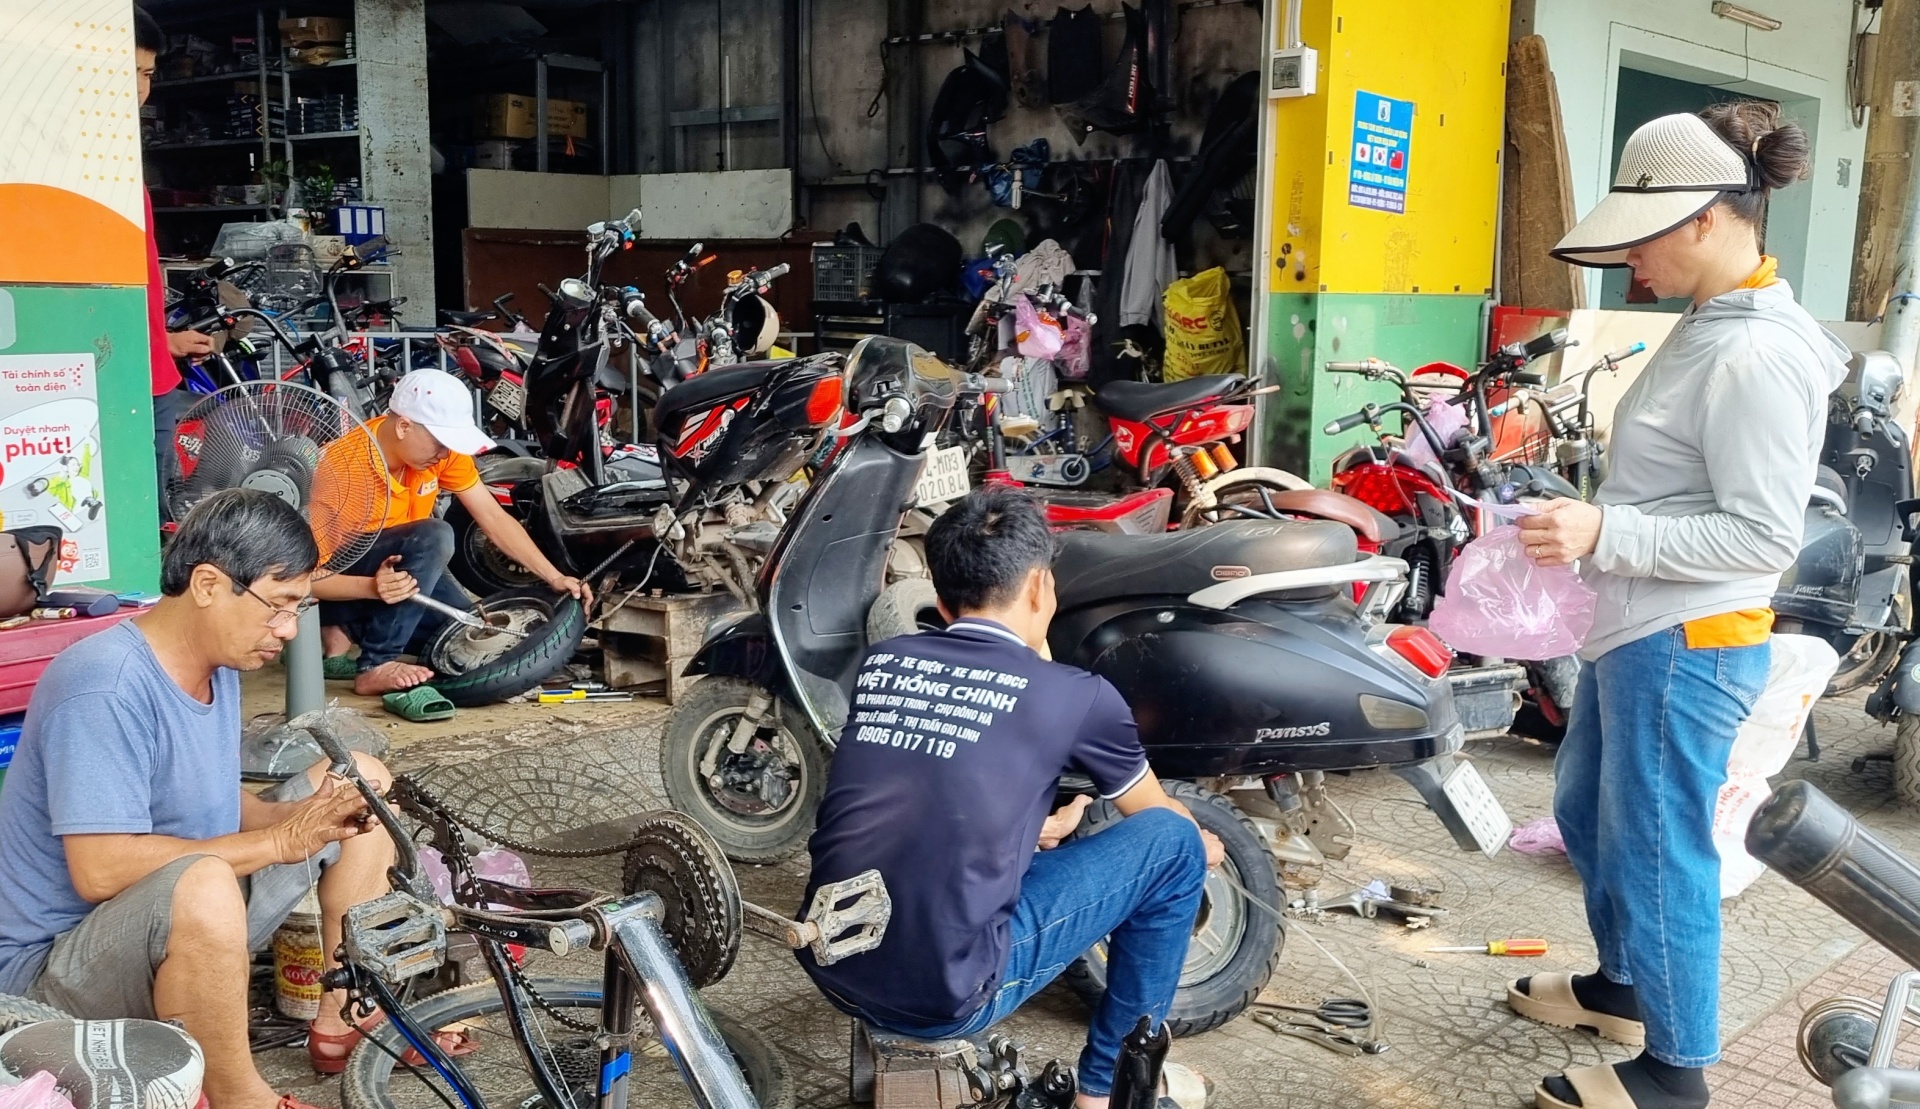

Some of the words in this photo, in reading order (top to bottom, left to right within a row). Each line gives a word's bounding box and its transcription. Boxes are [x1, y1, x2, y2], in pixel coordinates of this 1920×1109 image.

[2, 370, 20, 379] Tài
[21, 369, 51, 378] chính
[53, 367, 66, 378] số
[15, 383, 42, 393] toàn
[44, 382, 67, 393] diện
[4, 425, 36, 436] Duyệt
[39, 424, 71, 433] nhanh
[5, 436, 72, 463] phút!
[919, 473, 966, 501] 020.84
[900, 656, 918, 669] XE
[951, 666, 970, 678] XE
[968, 669, 997, 682] MÁY
[996, 673, 1029, 689] 50CC
[857, 668, 893, 690] VIỆT
[892, 674, 951, 697] HỒNG
[951, 686, 1018, 712] CHINH
[866, 694, 888, 705] PHAN
[886, 695, 905, 706] CHU
[903, 697, 930, 711] TRINH
[934, 703, 955, 717] CHỢ
[977, 712, 993, 726] HÀ
[868, 710, 879, 722] LÊ
[903, 715, 919, 730] THỊ
[918, 718, 942, 732] TRẤN
[940, 723, 957, 736] GIO
[956, 726, 981, 743] LINH
[856, 725, 892, 745] 0905
[891, 730, 924, 751] 017
[926, 737, 957, 759] 119
[478, 924, 518, 938] GAXY
